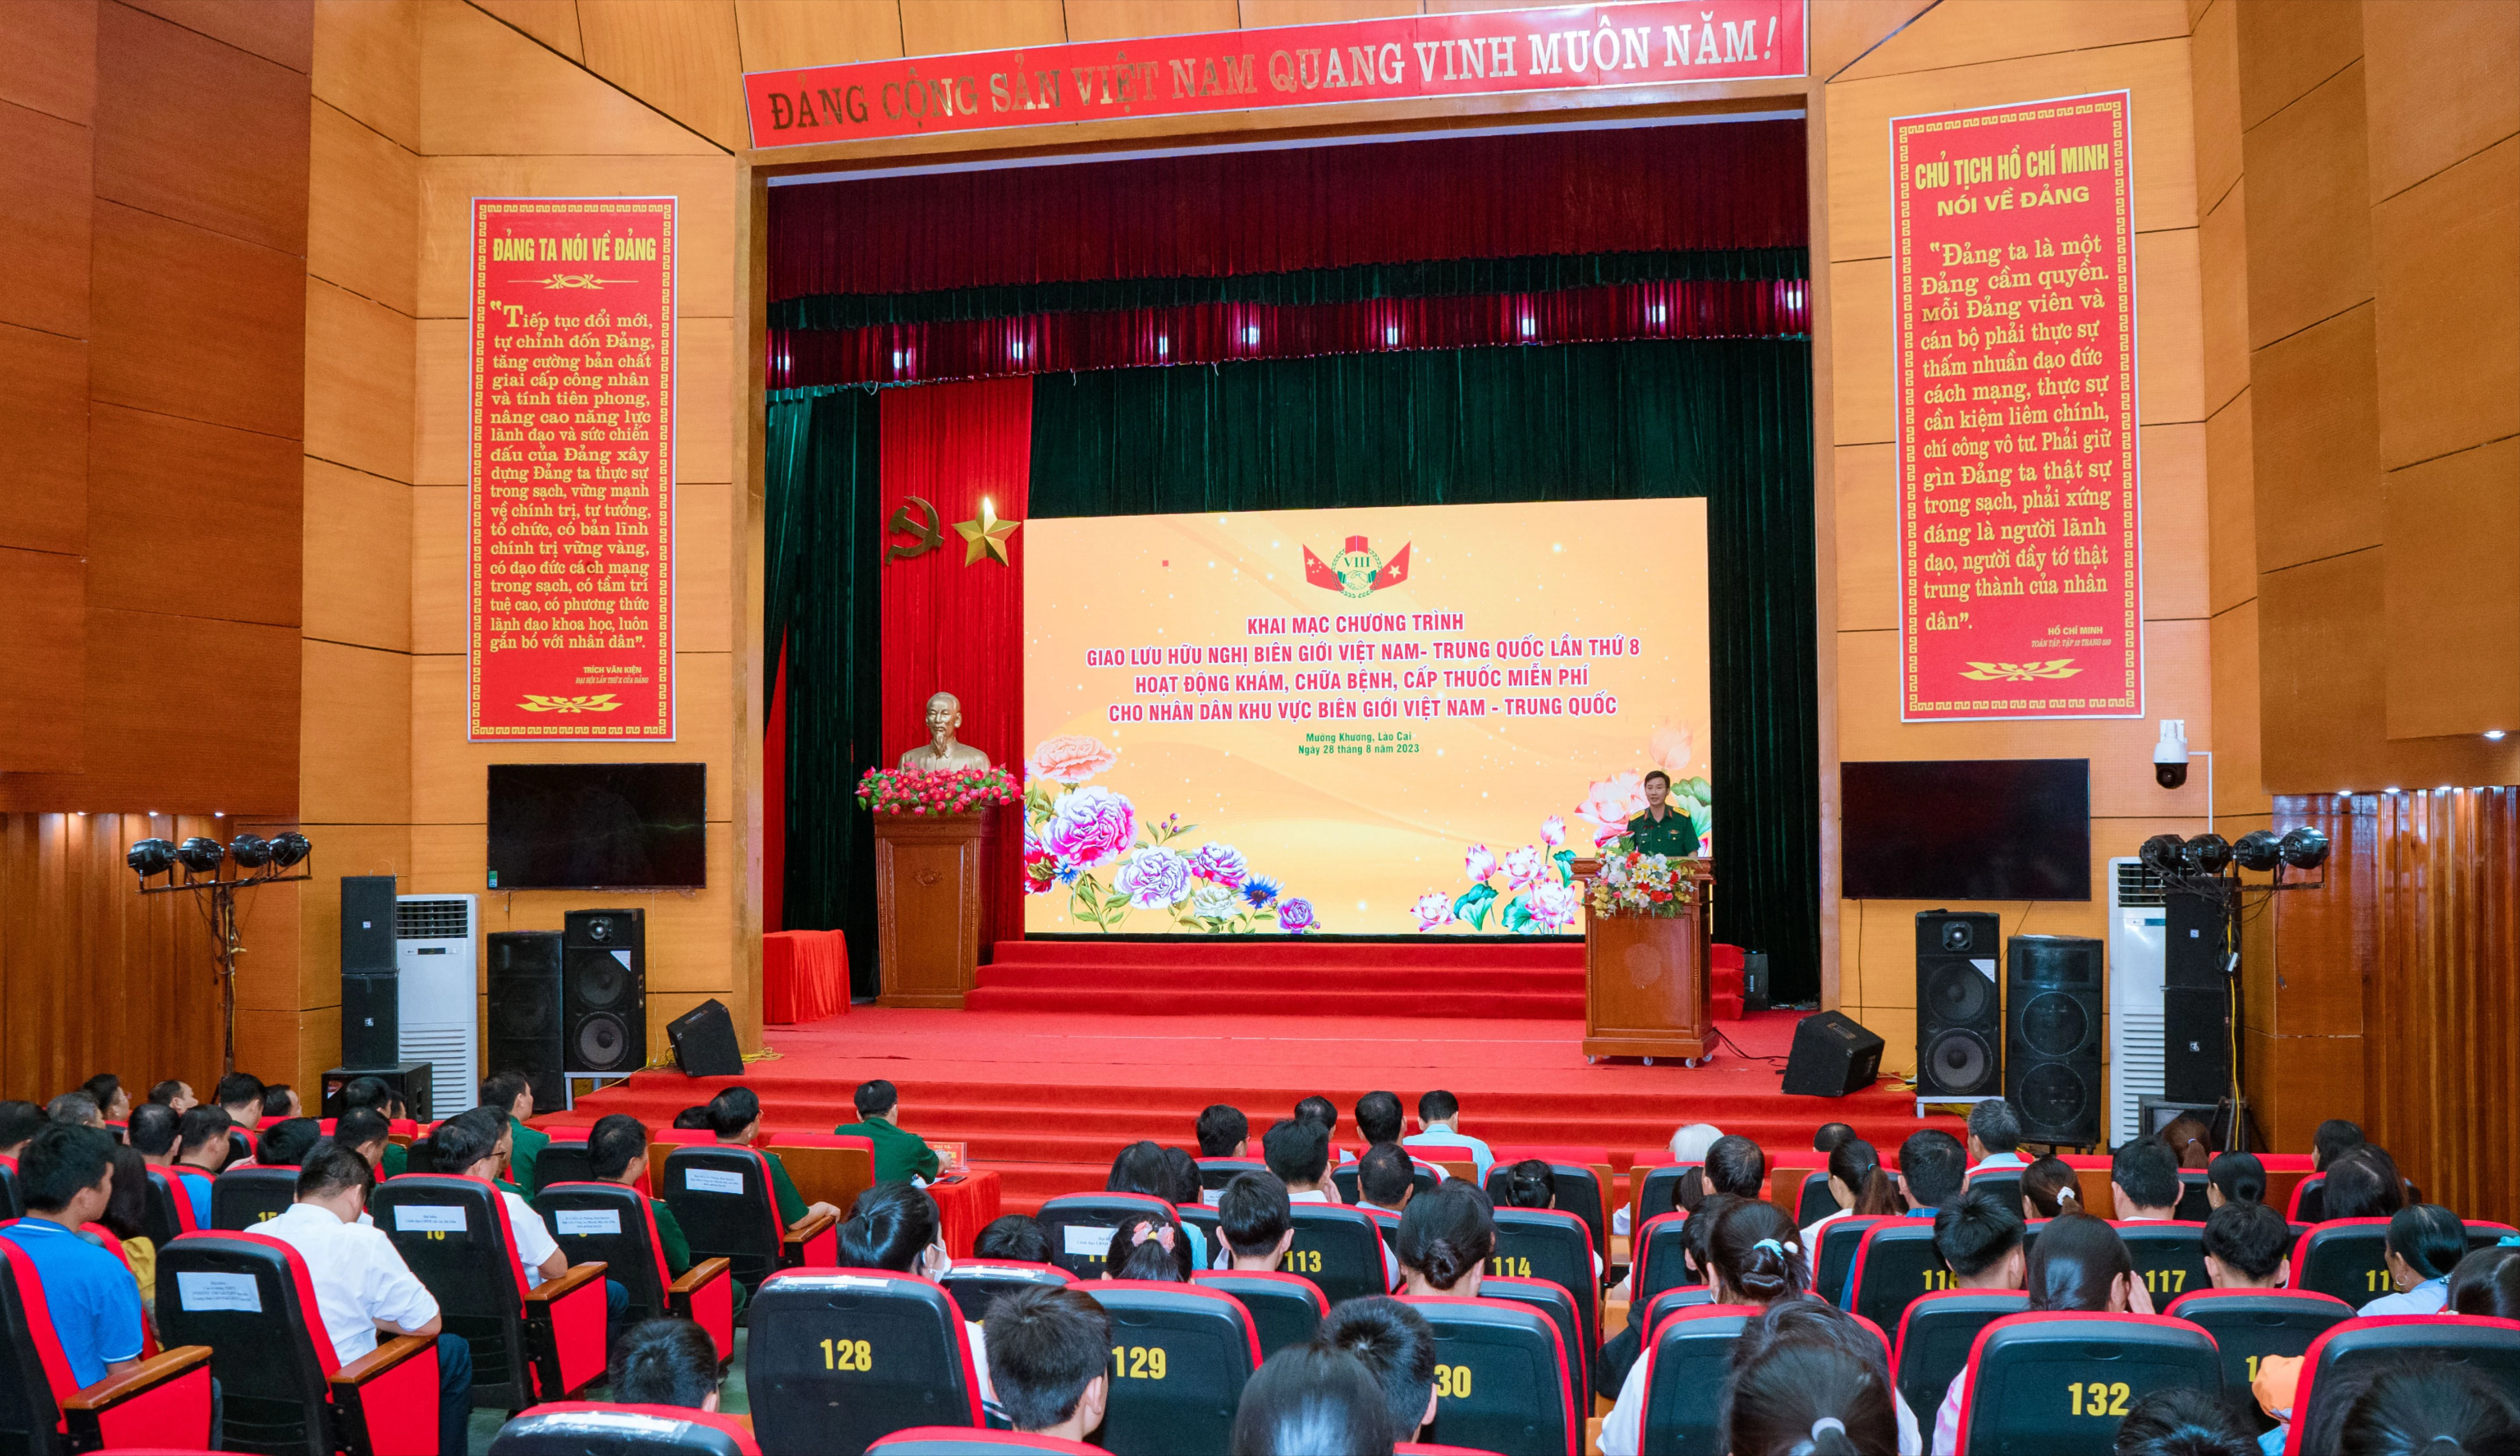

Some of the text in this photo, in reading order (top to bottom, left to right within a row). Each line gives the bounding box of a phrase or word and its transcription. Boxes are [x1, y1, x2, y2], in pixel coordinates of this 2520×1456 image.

[768, 73, 870, 131] ĐẢNG
[882, 67, 979, 129] CỘNG
[990, 53, 1062, 112] SẢN
[1071, 51, 1159, 113] VIỆT
[1169, 54, 1256, 100] NAM
[1269, 42, 1405, 92] QUANG
[1414, 35, 1518, 82] VINH
[1528, 15, 1651, 74] MUÔN
[1915, 143, 2109, 191] CHỦ TỊCH HỒ CHÍ MINH
[1937, 183, 2089, 216] NÓI VỀ ĐẢNG
[493, 227, 656, 262] ĐẢNG TA NÓI VỀ ĐẢNG
[2008, 243, 2028, 261] ta
[2034, 237, 2055, 258] là
[2061, 233, 2102, 258] một
[1966, 295, 2022, 320] Đảng
[2028, 292, 2074, 313] viên
[2079, 288, 2105, 308] và
[554, 315, 580, 331] tục
[584, 308, 611, 327] đổi
[616, 312, 653, 329] mới,
[1923, 346, 2102, 378] thấm nhuần đạo đức
[492, 370, 650, 390] giai cấp công nhân
[490, 443, 650, 465] đấu của Đảng xây
[1924, 438, 1947, 458] chí
[1952, 436, 1990, 460] công
[1994, 434, 2013, 453] vô
[2042, 426, 2078, 451] Phải
[2083, 428, 2112, 454] giữ
[490, 518, 649, 537] tổ chức, có bản lĩnh
[1924, 516, 2107, 547] đáng là người lãnh
[1344, 556, 1370, 567] VIII
[1248, 610, 1463, 637] KHAI MẠC CHƯƠNG TRÌNH
[2063, 625, 2078, 635] CHÍ
[490, 632, 517, 652] gắn
[521, 631, 538, 648] bó
[542, 634, 564, 648] với
[569, 634, 605, 648] nhân
[1087, 650, 1125, 666] GIAO
[1131, 647, 1161, 665] LƯU
[1168, 644, 1202, 664] HỮU
[1209, 647, 1247, 666] NGHỊ
[1254, 642, 1292, 662] BIÊN
[1299, 641, 1332, 662] GIỚI
[1338, 640, 1375, 664] VIỆT
[1433, 641, 1490, 659] TRUNG
[1497, 635, 1543, 659] QUỐC
[1551, 634, 1582, 656] LẦN
[1589, 635, 1624, 655] THỨ
[1630, 639, 1639, 655] 8
[624, 665, 641, 675] KIỆN
[1136, 663, 1589, 696] HOẠT ĐỘNG KHÁM, CHỮA BỆNH, CẤP THUỐC MIỄN PHÍ
[1109, 705, 1143, 721] CHO
[1150, 700, 1193, 721] NHÂN
[1200, 700, 1232, 720] DÂN
[1239, 703, 1271, 719] KHU
[1278, 700, 1311, 722] VỰC
[1319, 698, 1356, 718] BIÊN
[1363, 699, 1397, 717] GIỚI
[1404, 696, 1441, 721] VIỆT
[1447, 699, 1485, 716] NAM
[1504, 698, 1561, 715] TRUNG
[1569, 691, 1616, 716] QUỐC
[1299, 744, 1419, 756] Ngày 28 tháng 8 năm 2023
[1306, 732, 1412, 743] Mường Khương, Lào Cai
[1285, 1251, 1321, 1272] 113
[1493, 1257, 1531, 1278] 114
[2145, 1270, 2186, 1293] 117
[2366, 1270, 2401, 1291] 11
[820, 1339, 872, 1371] 128
[1112, 1346, 1166, 1379] 129
[1434, 1364, 1471, 1398] 30
[2068, 1382, 2130, 1416] 132
